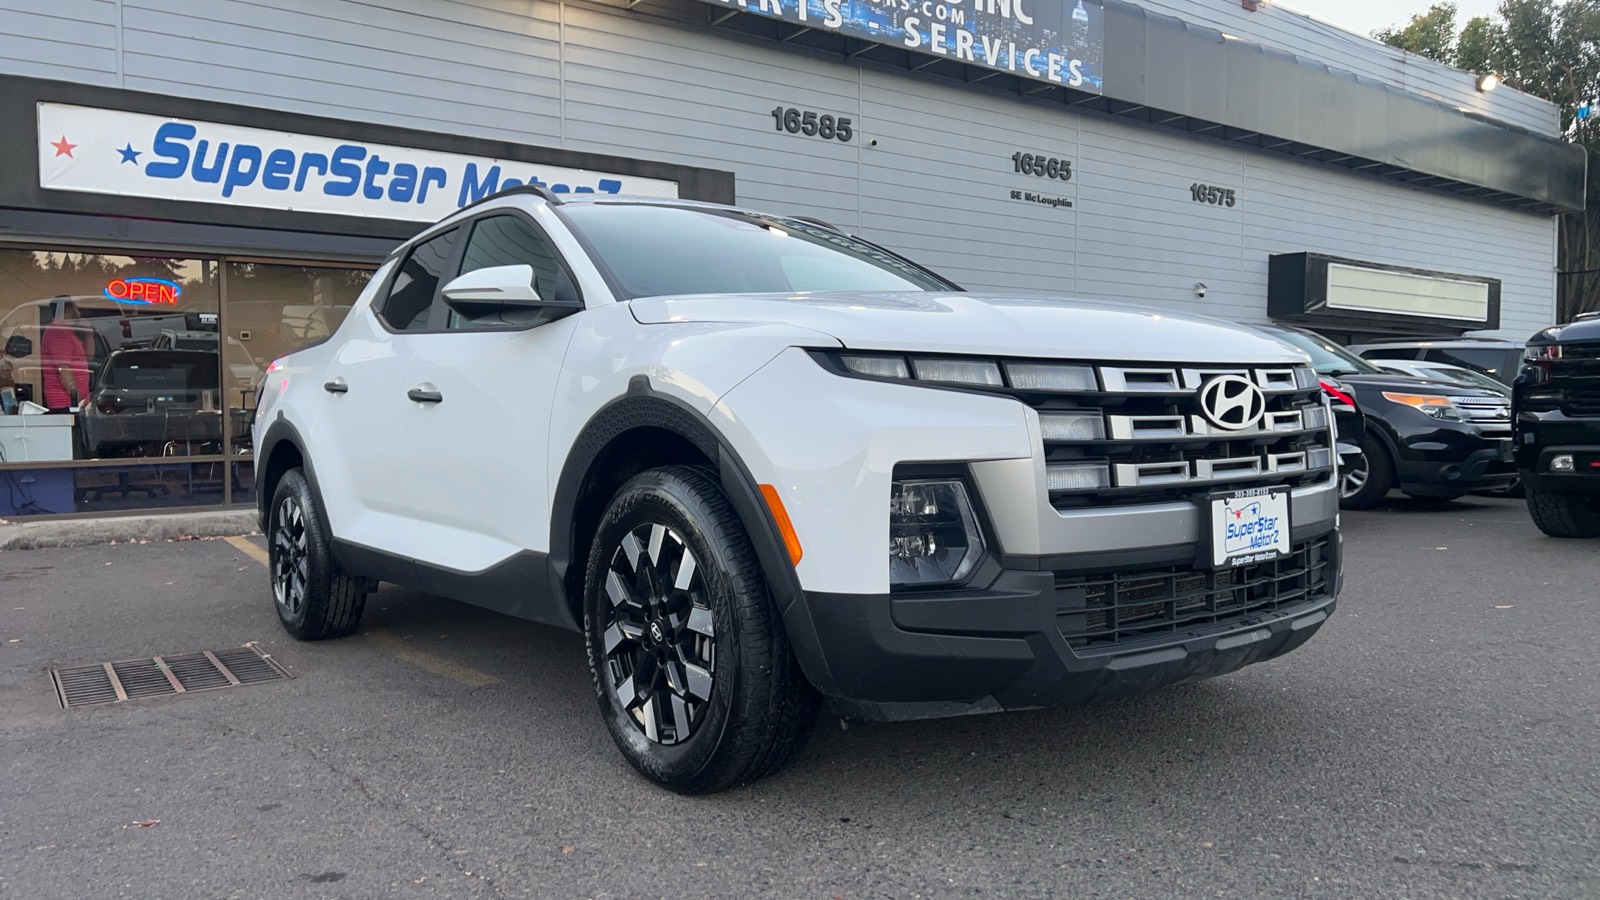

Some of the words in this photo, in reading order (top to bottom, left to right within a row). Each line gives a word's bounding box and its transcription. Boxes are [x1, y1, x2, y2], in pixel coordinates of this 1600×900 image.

[904, 16, 1083, 87] SERVICES
[772, 106, 852, 142] 16585
[145, 122, 447, 204] SuperStar
[1012, 151, 1072, 181] 16565
[1010, 190, 1022, 200] SE
[1024, 192, 1072, 208] McLoughlin
[1190, 183, 1236, 207] 16575
[108, 279, 176, 304] OPEN
[1227, 517, 1278, 541] SuperStar
[583, 614, 602, 698] KUMHO
